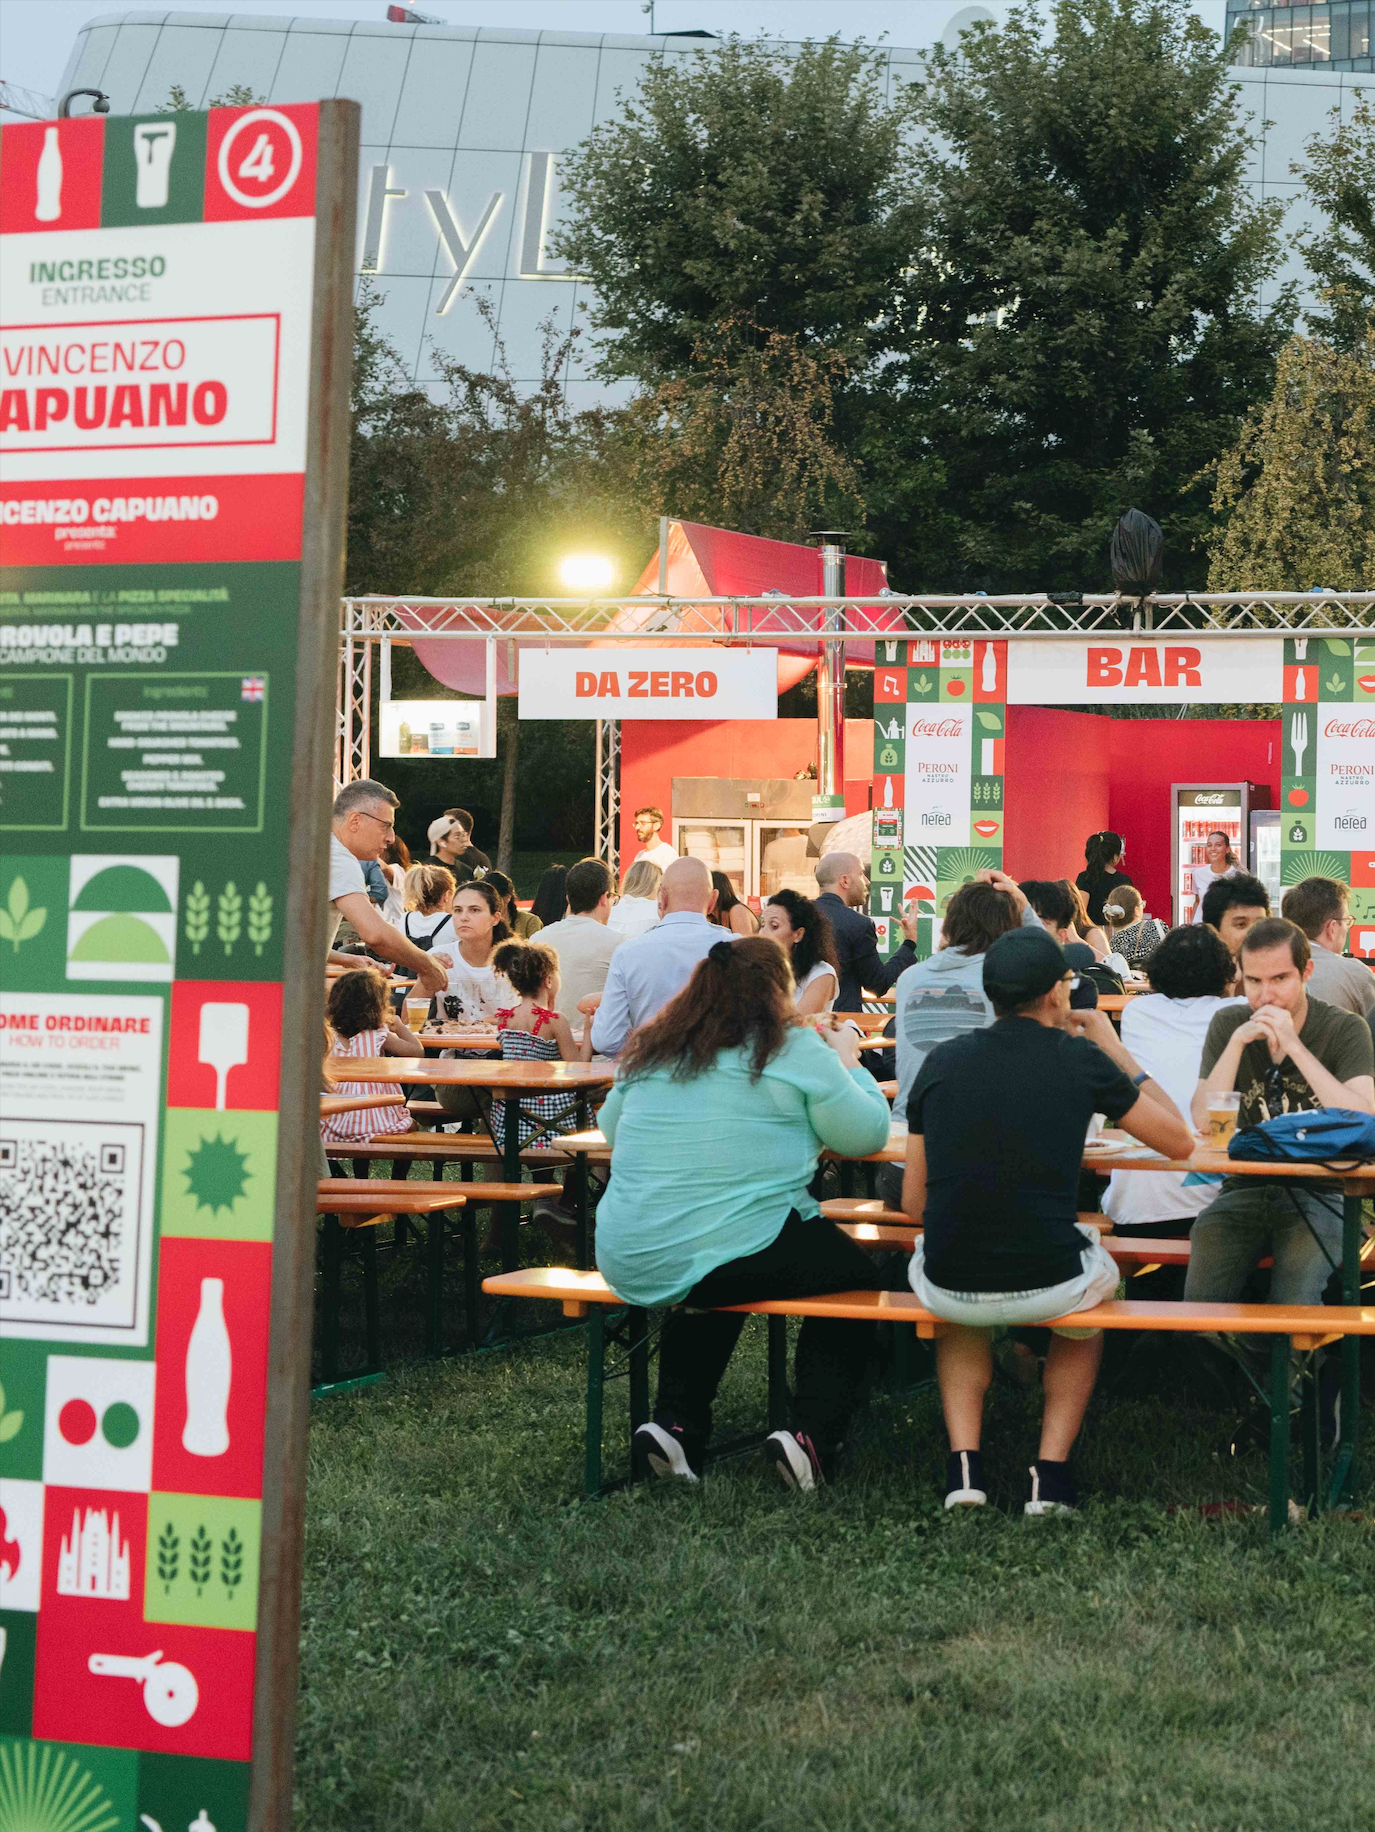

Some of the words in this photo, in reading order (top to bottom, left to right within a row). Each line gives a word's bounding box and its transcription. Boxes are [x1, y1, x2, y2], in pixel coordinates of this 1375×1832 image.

[238, 133, 275, 183] 4
[29, 256, 167, 284] INGRESSO
[41, 282, 152, 307] ENTRANCE
[4, 338, 187, 377] VINCENZO
[0, 380, 228, 432] APUANO
[0, 499, 90, 525] CENZO
[92, 494, 219, 522] CAPUANO
[0, 625, 93, 648] ROVOLA
[96, 625, 112, 646] E
[114, 623, 179, 646] PEPE
[77, 647, 106, 664] DEL
[107, 646, 167, 663] MONDO
[1086, 646, 1202, 688] BAR
[574, 670, 620, 698] DA
[627, 670, 718, 698] ZERO
[917, 762, 959, 774] PERONI
[1329, 763, 1375, 776] PERONI
[0, 1013, 39, 1030] OME
[45, 1014, 151, 1034] ORDINARE
[9, 1034, 43, 1048] HOW
[48, 1034, 65, 1048] TO
[69, 1034, 121, 1050] ORDER
